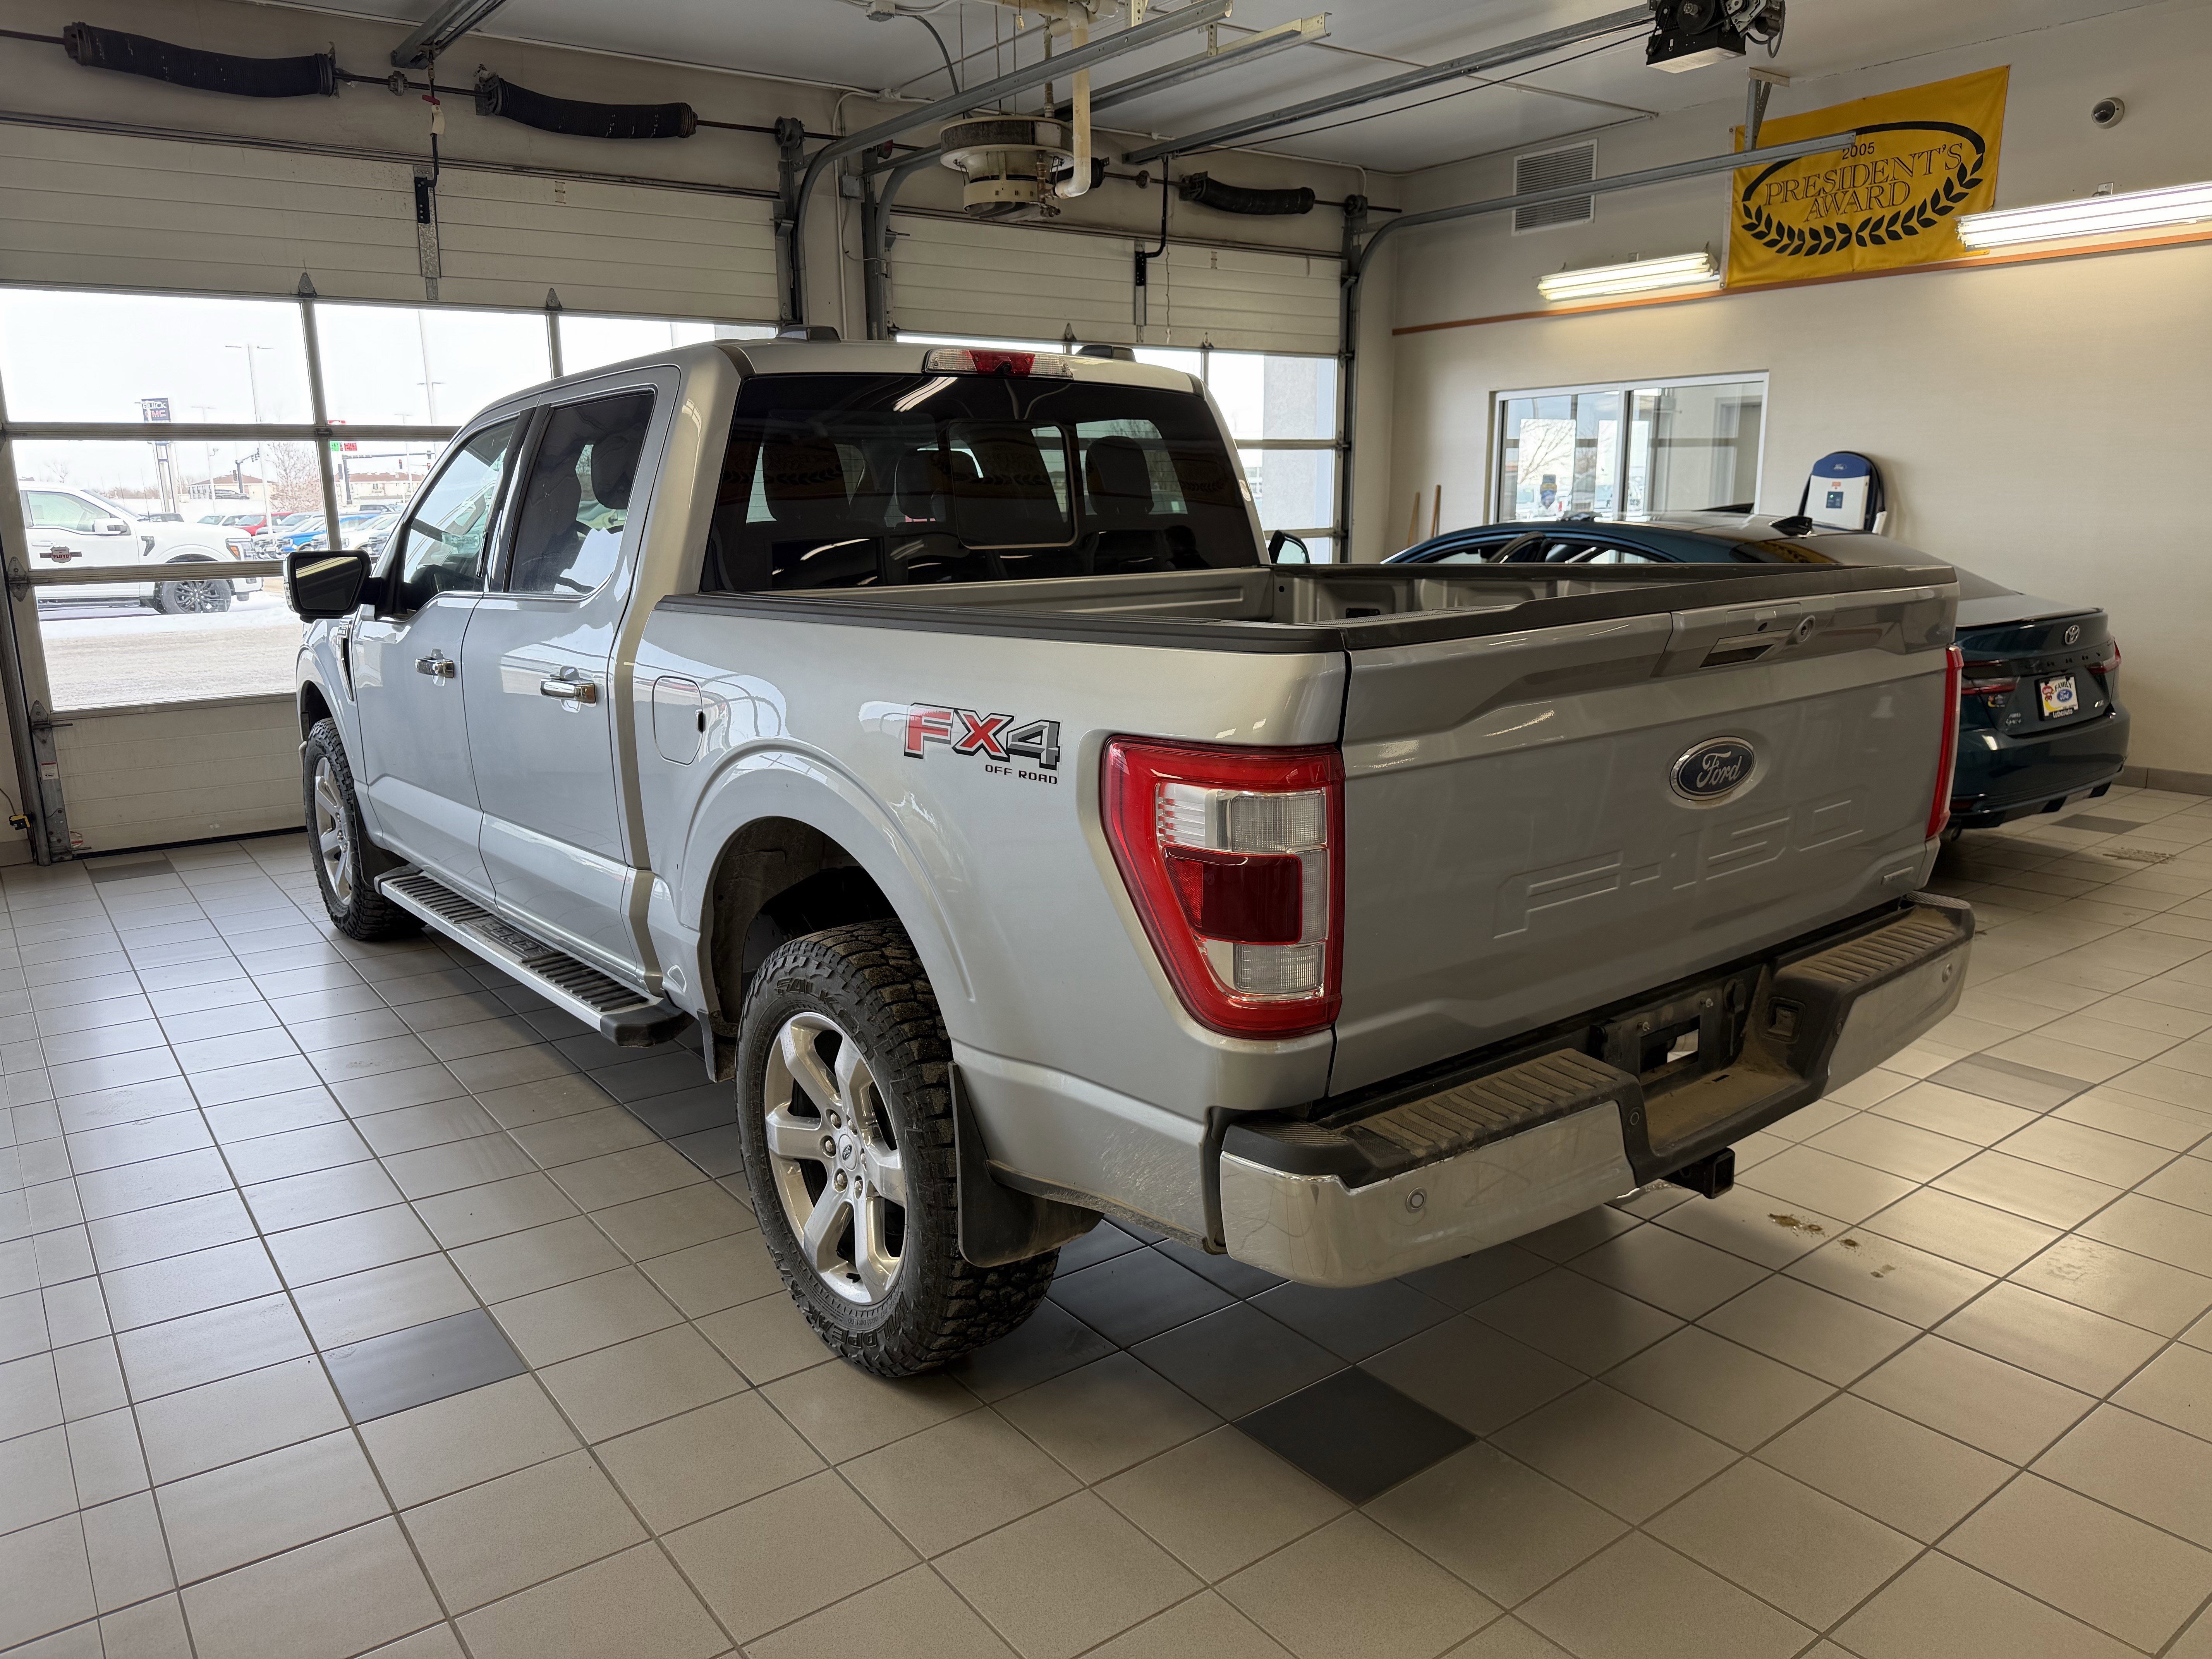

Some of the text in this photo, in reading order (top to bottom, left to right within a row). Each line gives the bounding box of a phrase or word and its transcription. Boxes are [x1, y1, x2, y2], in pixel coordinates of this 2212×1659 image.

[1842, 142, 1874, 160] 2005
[1763, 143, 1963, 206] PRESIDENT'S
[1803, 181, 1910, 223] AWARD
[2055, 681, 2072, 692] FAMILY
[904, 702, 1061, 770] FX4
[985, 764, 1057, 784] OFF ROAD
[1696, 750, 1742, 788] Ford
[1492, 785, 1870, 939] F-150
